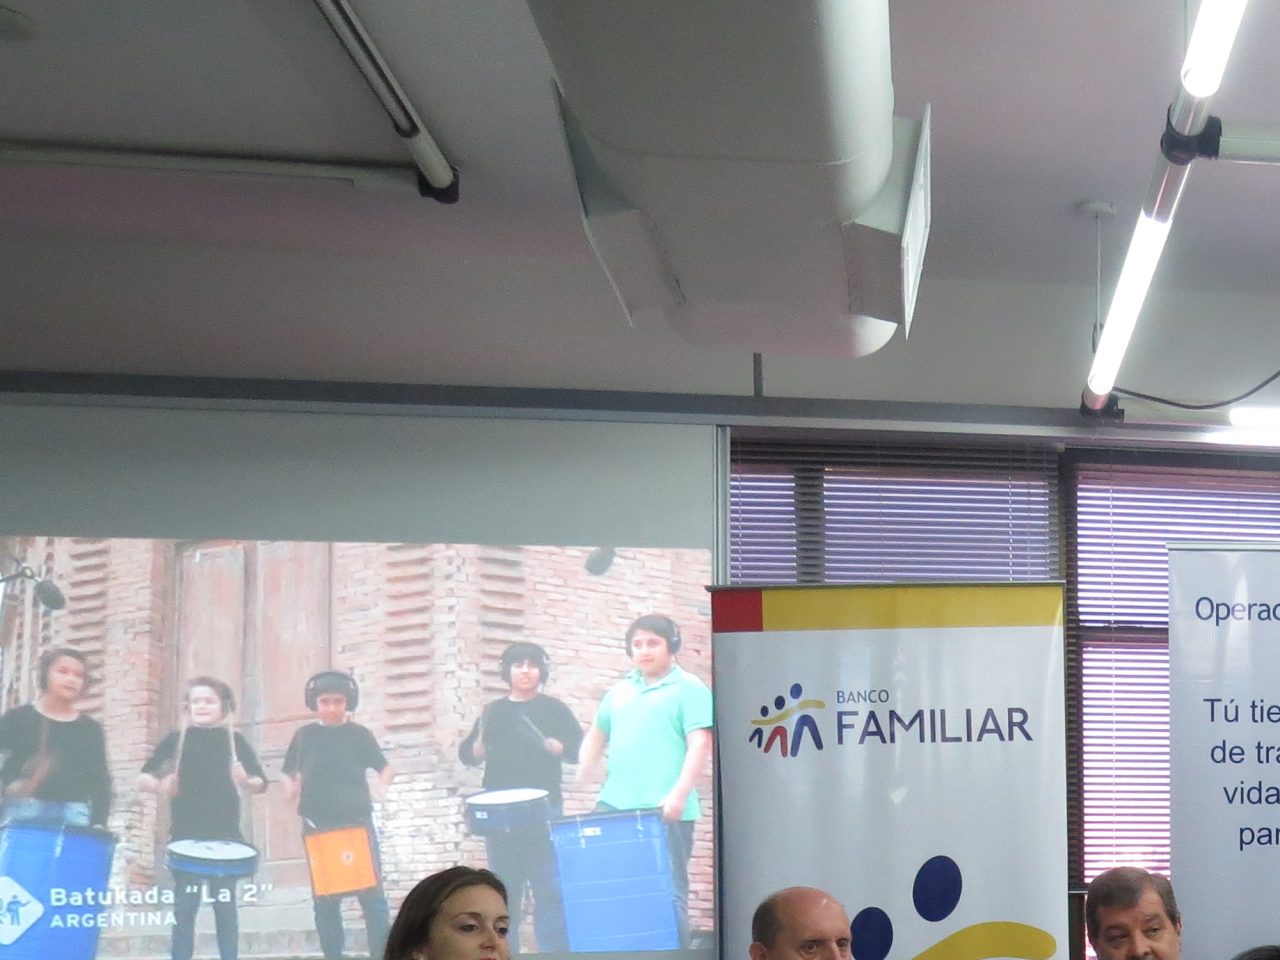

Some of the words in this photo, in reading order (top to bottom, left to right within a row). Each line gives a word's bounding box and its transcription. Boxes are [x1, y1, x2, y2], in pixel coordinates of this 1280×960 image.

[836, 689, 889, 704] BANCO
[1203, 698, 1239, 723] Tú
[837, 707, 1033, 745] FAMILIAR
[1210, 740, 1245, 764] de
[1223, 781, 1280, 805] vida
[50, 885, 175, 907] Batukada
[50, 911, 178, 928] ARGENTINA
